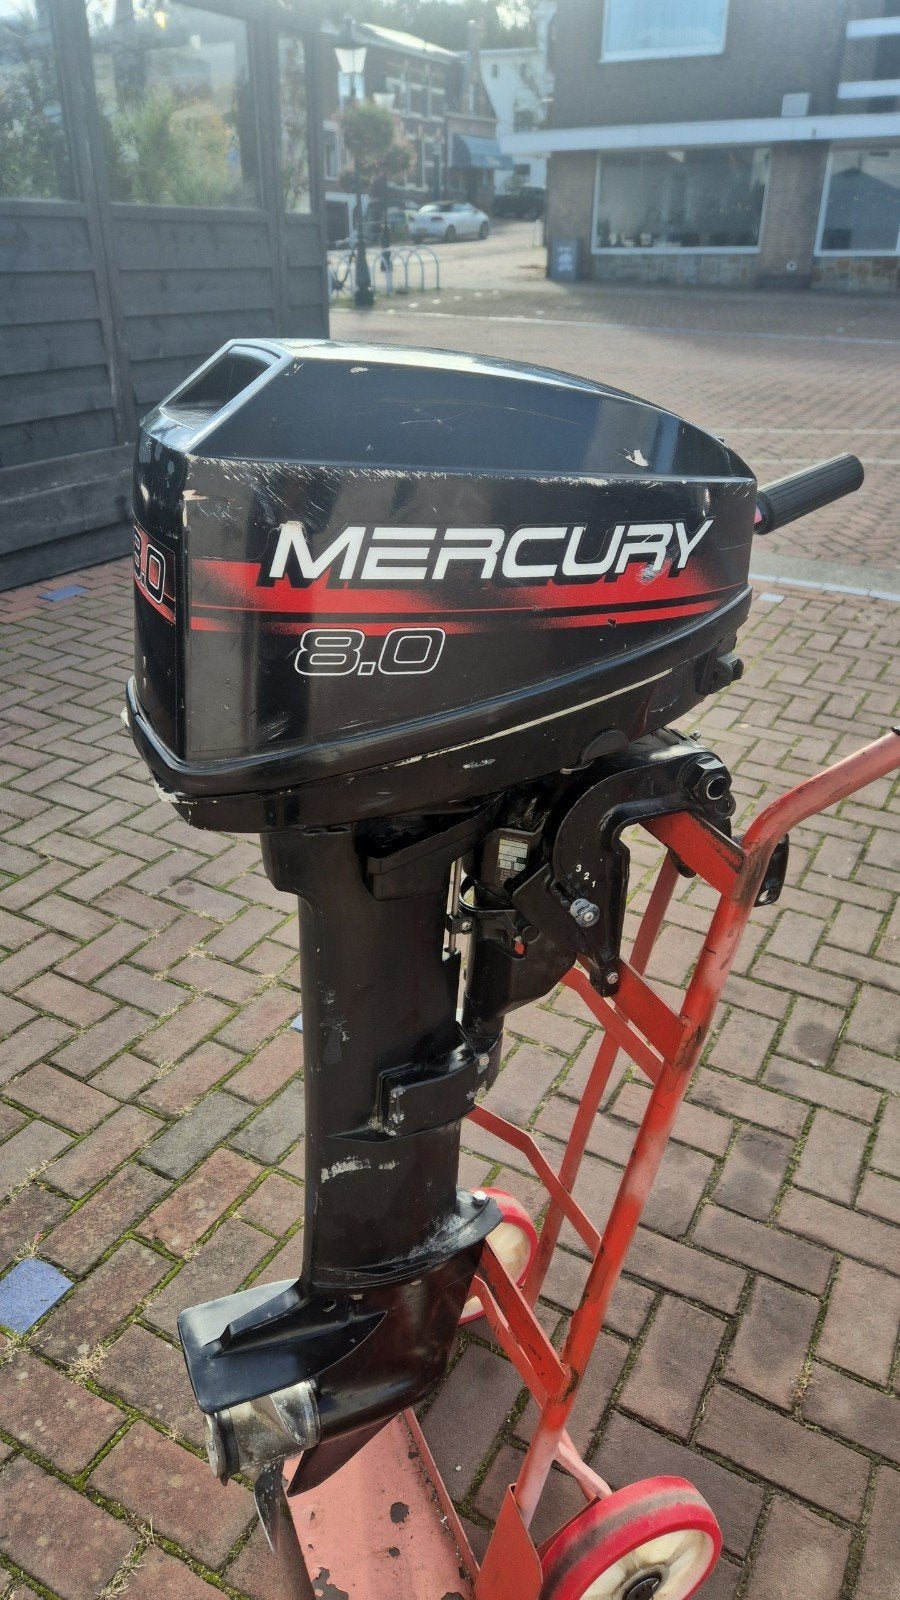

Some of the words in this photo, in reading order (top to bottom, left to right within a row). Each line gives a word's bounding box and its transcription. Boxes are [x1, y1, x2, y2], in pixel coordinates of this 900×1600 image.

[269, 520, 714, 580] MERCURY
[294, 627, 446, 676] 8.0
[575, 863, 582, 873] 3
[583, 871, 590, 880] 2
[591, 880, 597, 888] 1
